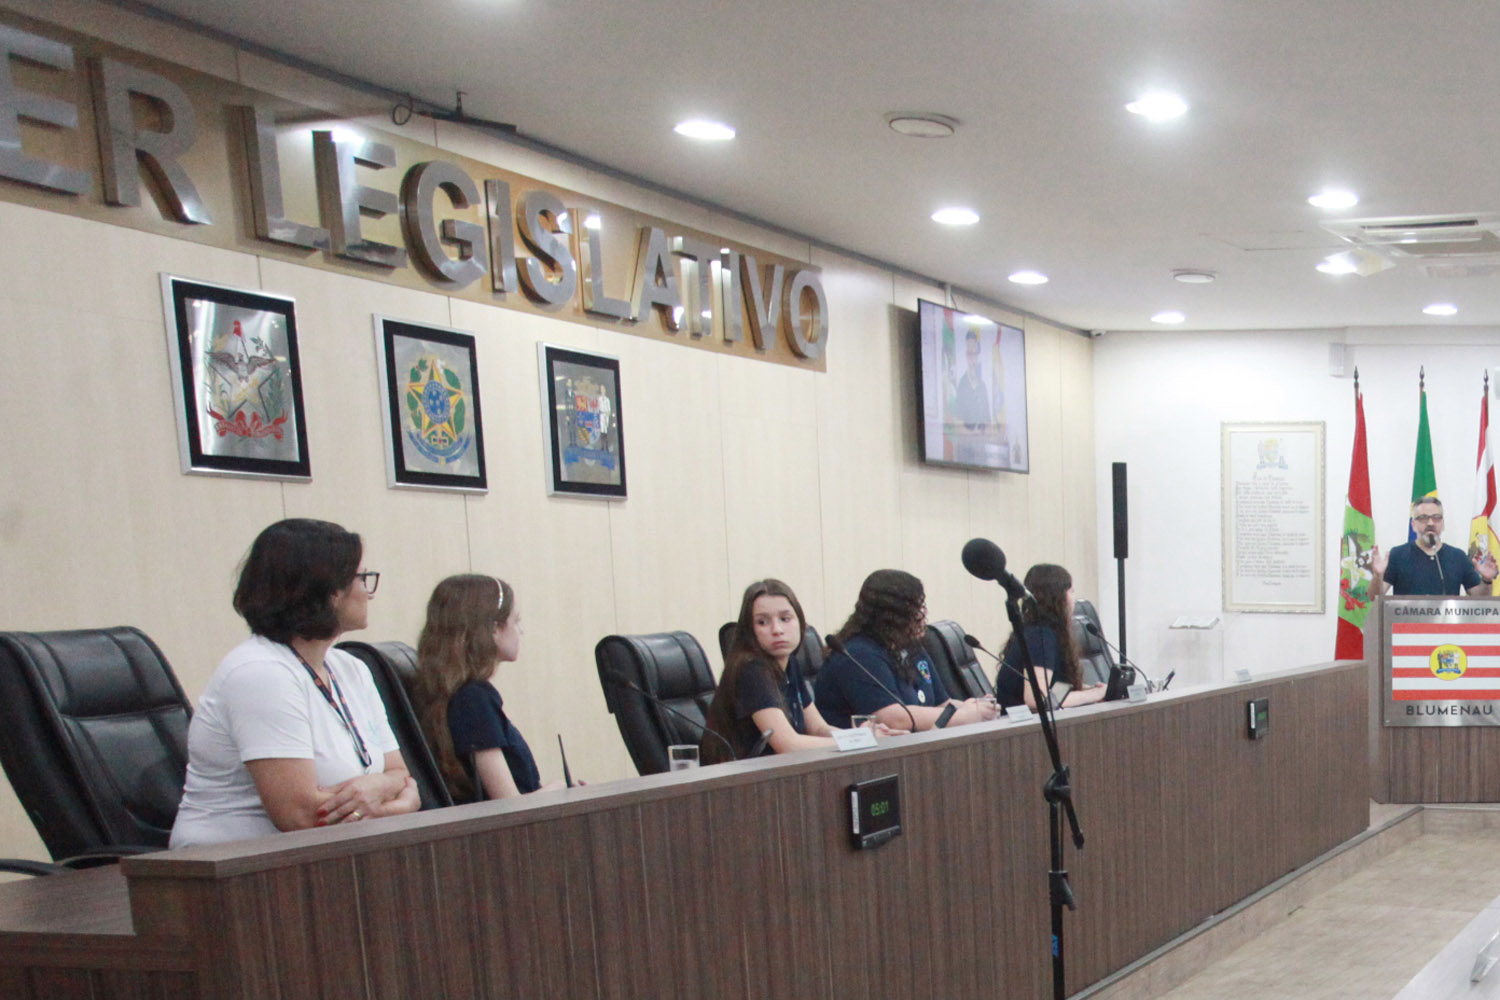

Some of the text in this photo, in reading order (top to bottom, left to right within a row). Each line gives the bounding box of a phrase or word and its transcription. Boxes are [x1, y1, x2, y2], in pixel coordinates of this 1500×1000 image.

[241, 104, 830, 360] LEGISLATIVO
[1394, 606, 1441, 617] CÂMARA
[1406, 704, 1493, 716] BLUMENAU
